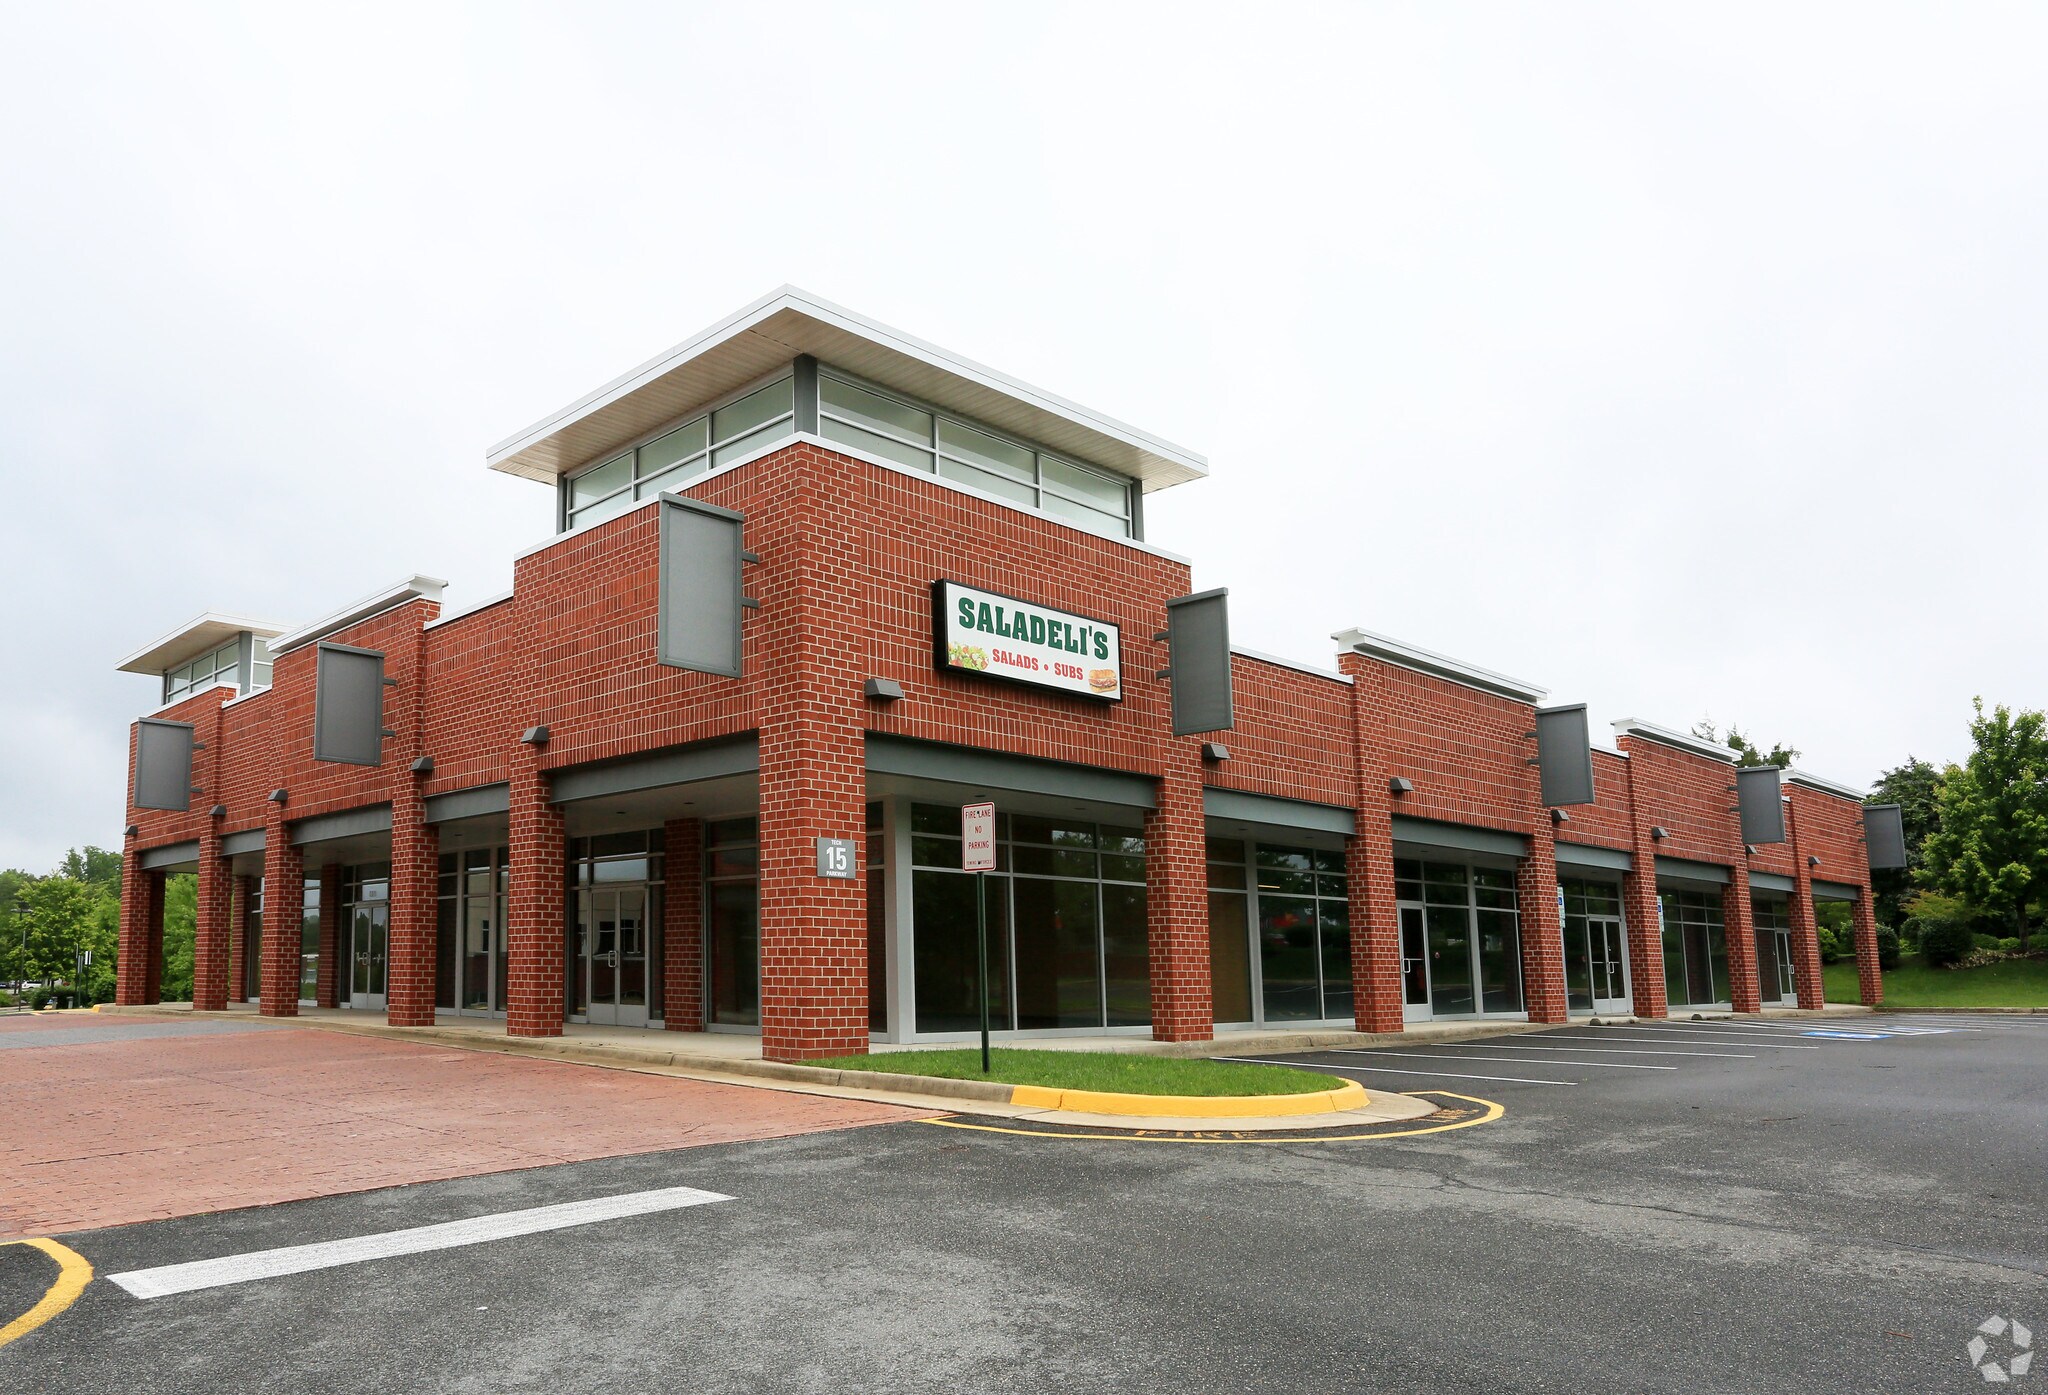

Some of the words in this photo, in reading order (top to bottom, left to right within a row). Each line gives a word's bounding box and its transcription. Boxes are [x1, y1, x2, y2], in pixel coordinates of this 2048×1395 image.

[958, 597, 1109, 660] SALADELI'S
[992, 648, 1039, 671] SALADS
[1054, 662, 1084, 680] SUBS
[965, 811, 976, 819] FIRE
[979, 809, 991, 818] LANE
[974, 825, 982, 834] NO
[968, 841, 989, 850] PARKING
[826, 846, 847, 870] 15
